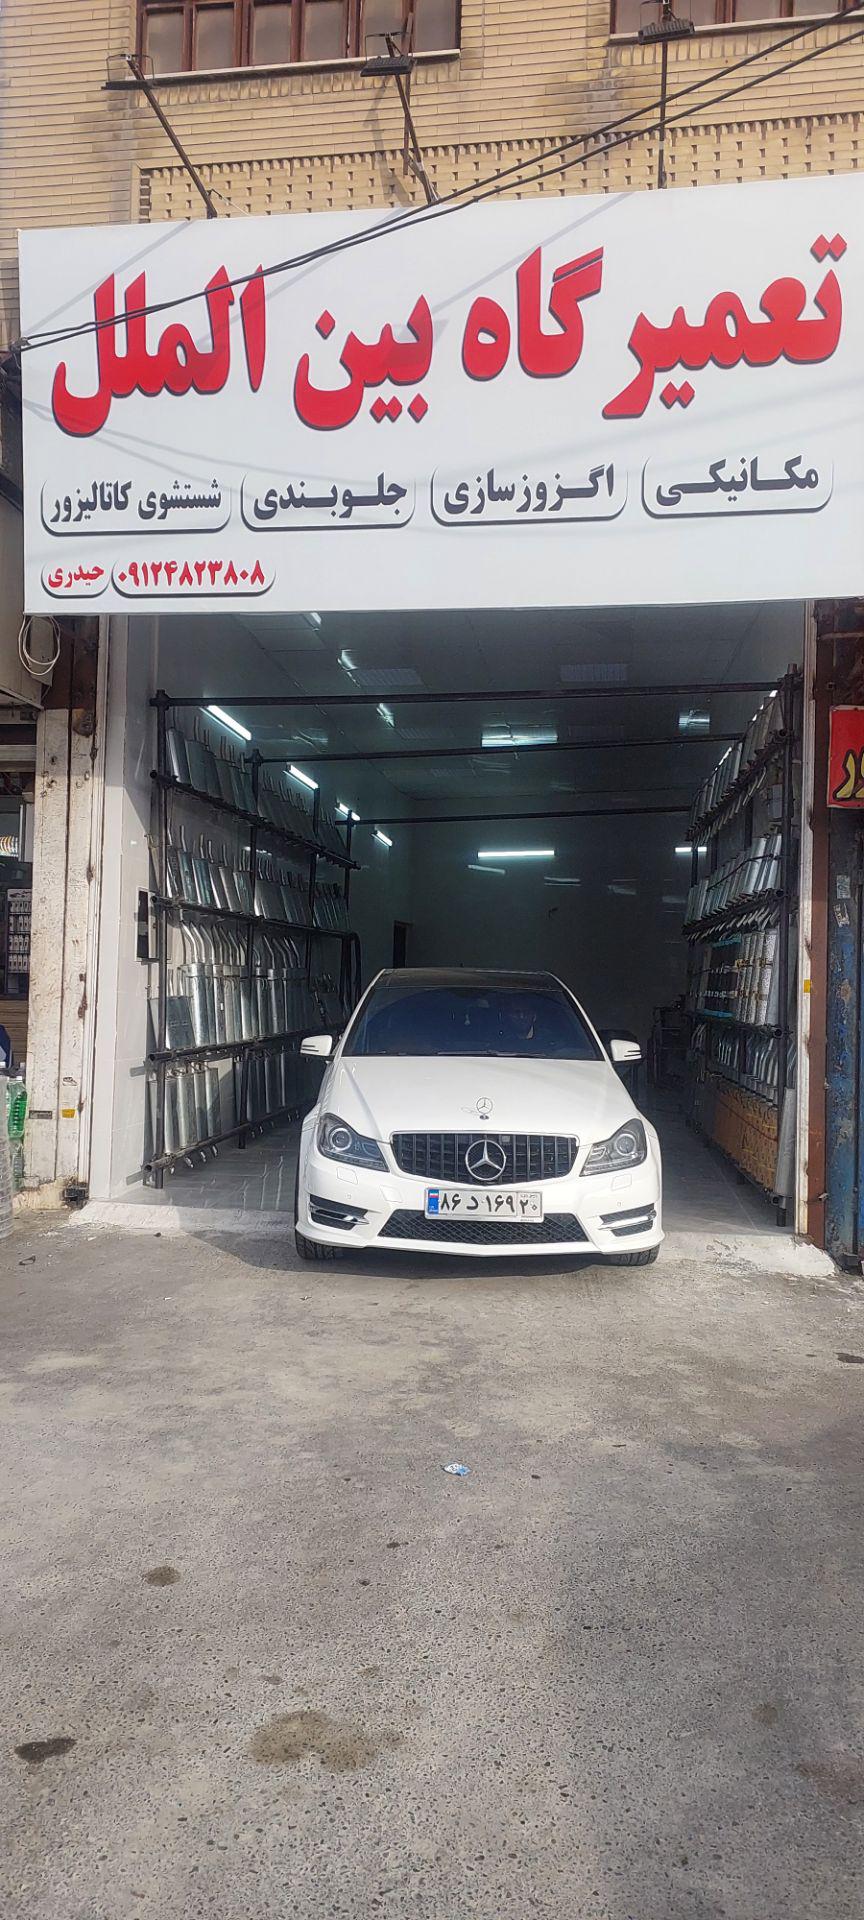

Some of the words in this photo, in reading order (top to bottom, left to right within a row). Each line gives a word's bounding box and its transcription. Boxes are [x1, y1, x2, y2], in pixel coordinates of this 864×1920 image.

[51, 264, 267, 437] الملل
[293, 295, 434, 430] بین
[49, 480, 132, 523] کاتالیزور
[137, 478, 222, 520] شستشوی
[253, 473, 408, 521] جلوبندی
[656, 455, 819, 507] مکانیکی
[47, 565, 105, 589] حیدری
[118, 560, 265, 587] ۰۹۱۲۴۸۲۳۸۰۸
